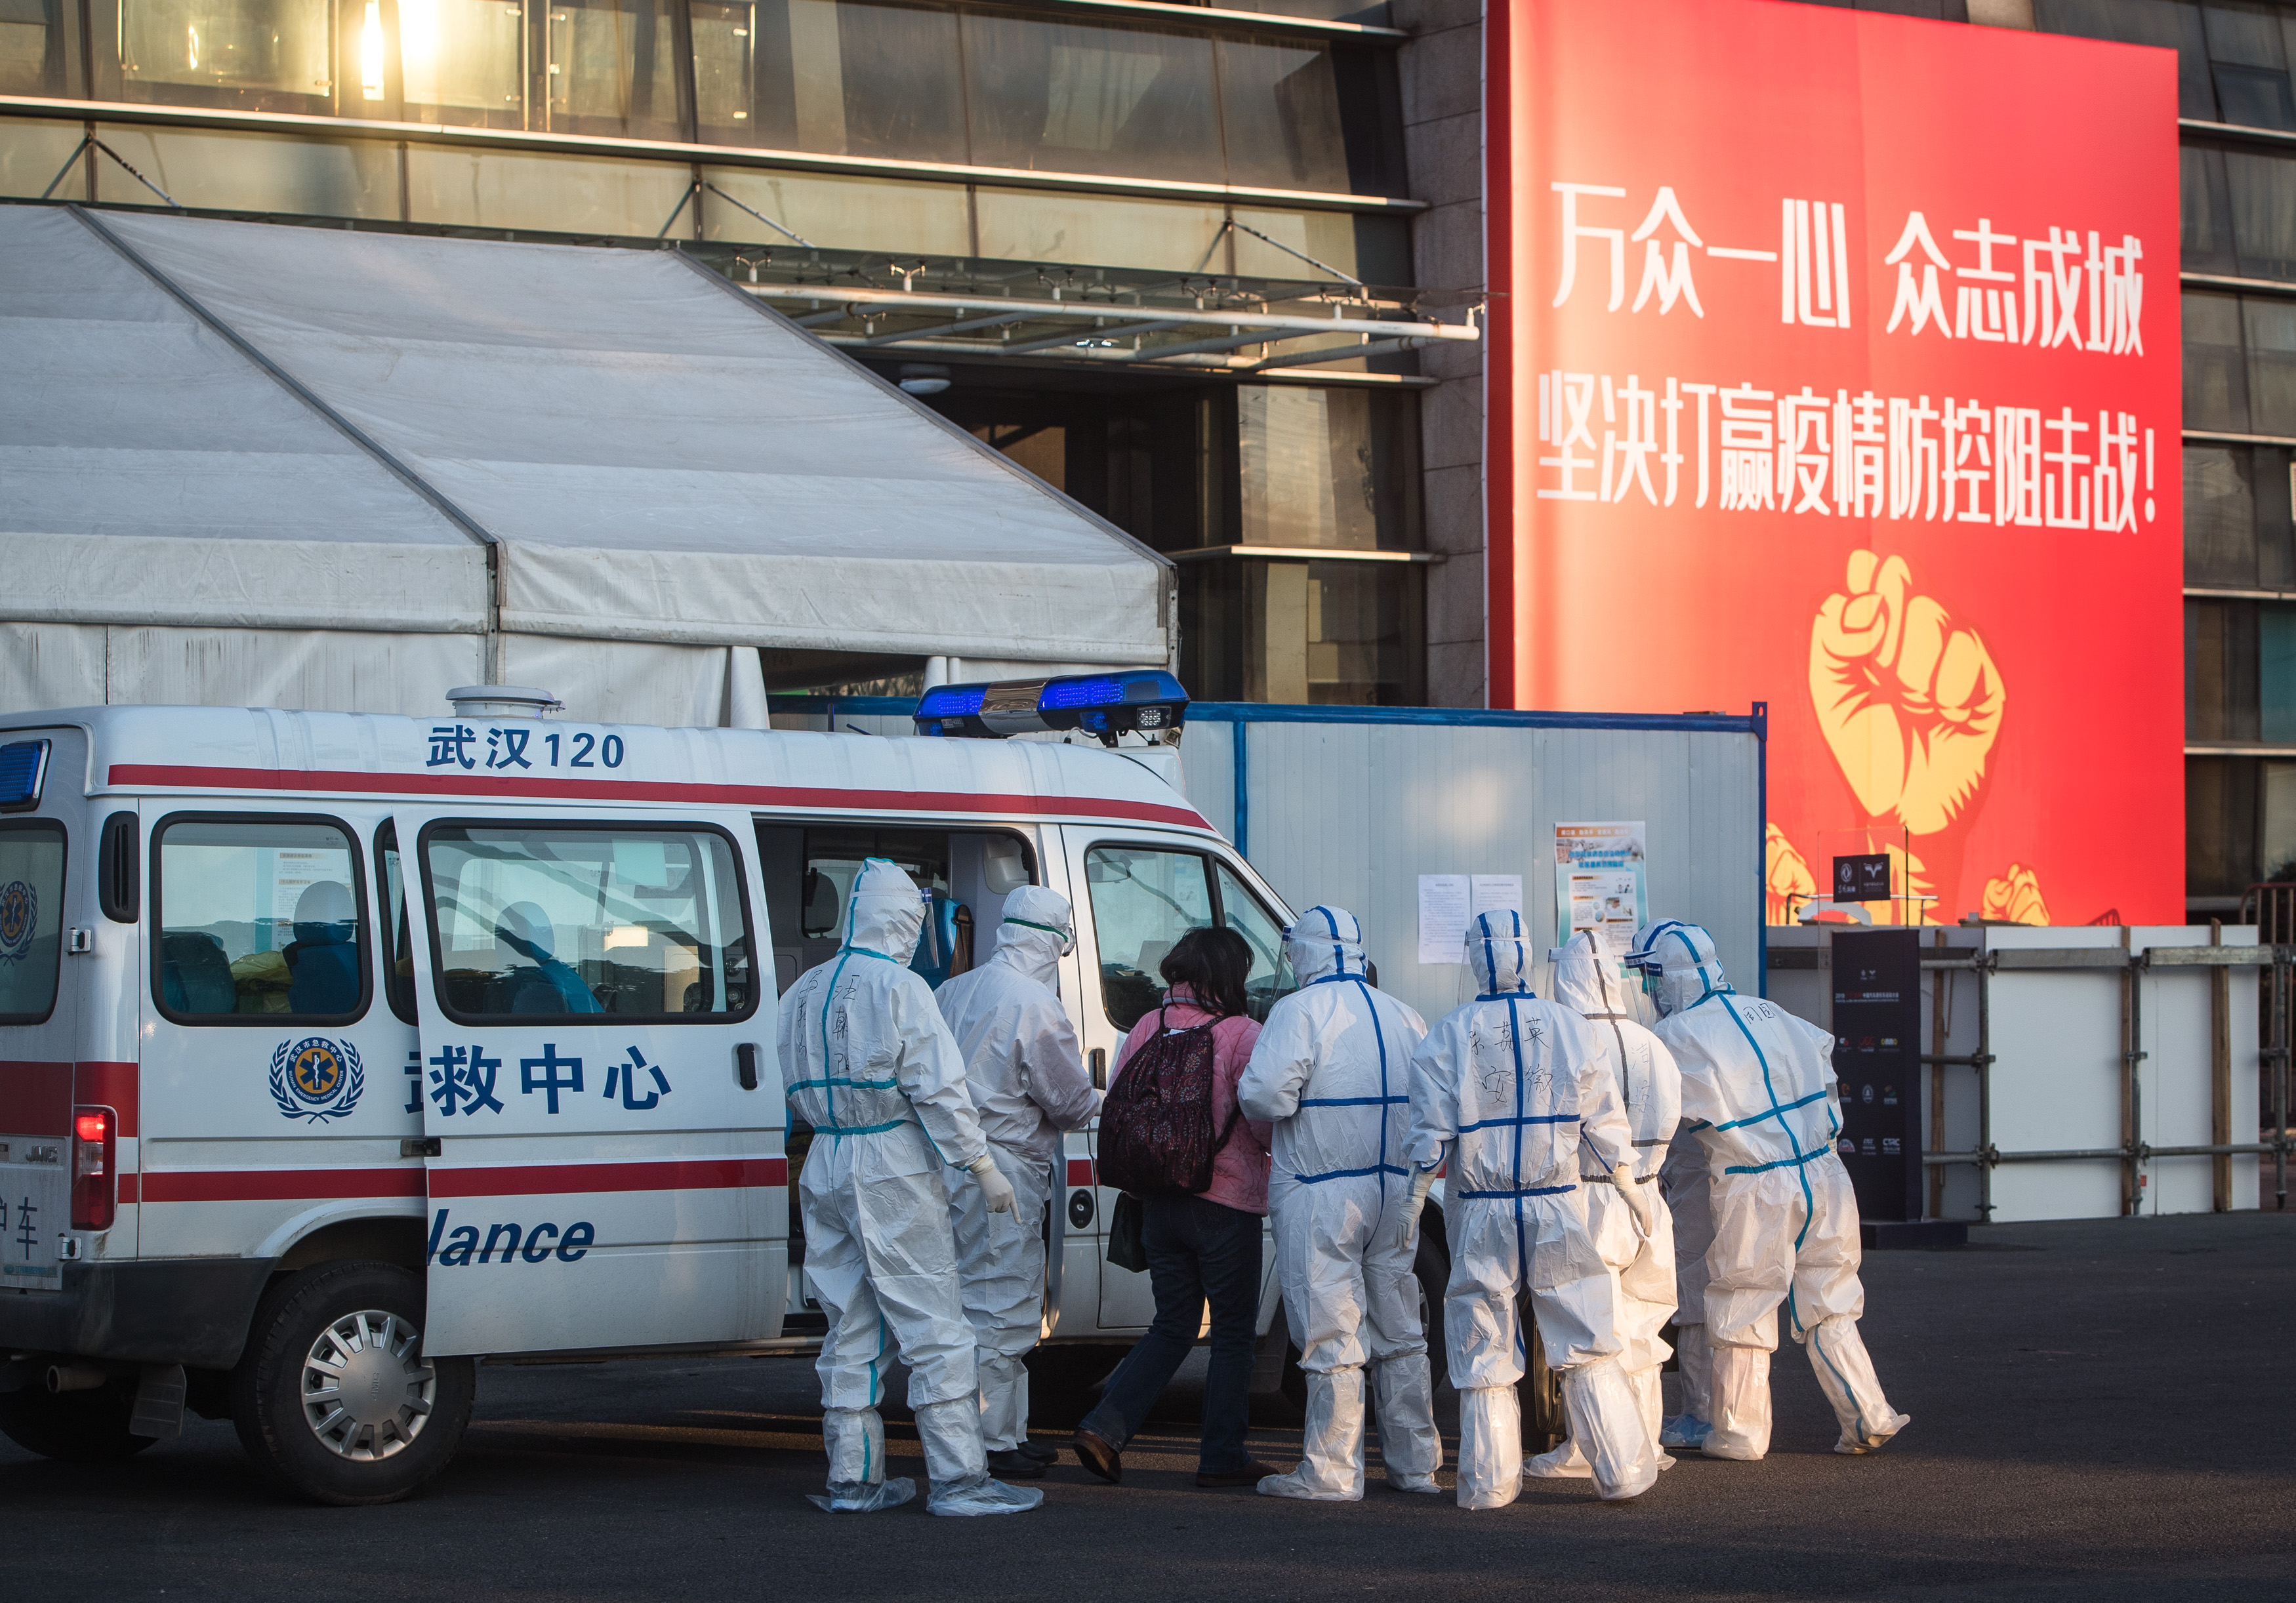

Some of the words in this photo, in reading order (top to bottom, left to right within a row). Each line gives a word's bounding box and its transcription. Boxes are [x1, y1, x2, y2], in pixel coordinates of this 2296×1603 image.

[1551, 181, 1851, 329] 万众一心
[1884, 211, 2144, 357] 众志成城
[1537, 368, 2156, 534] 坚决打赢疫情防控阻击战！
[425, 724, 625, 770] 武汉120
[289, 1039, 343, 1063] 武汉市急救中心
[288, 1070, 297, 1089] WUHAN
[295, 1087, 320, 1102] EMERGENCY
[321, 1087, 338, 1101] MEDICAL
